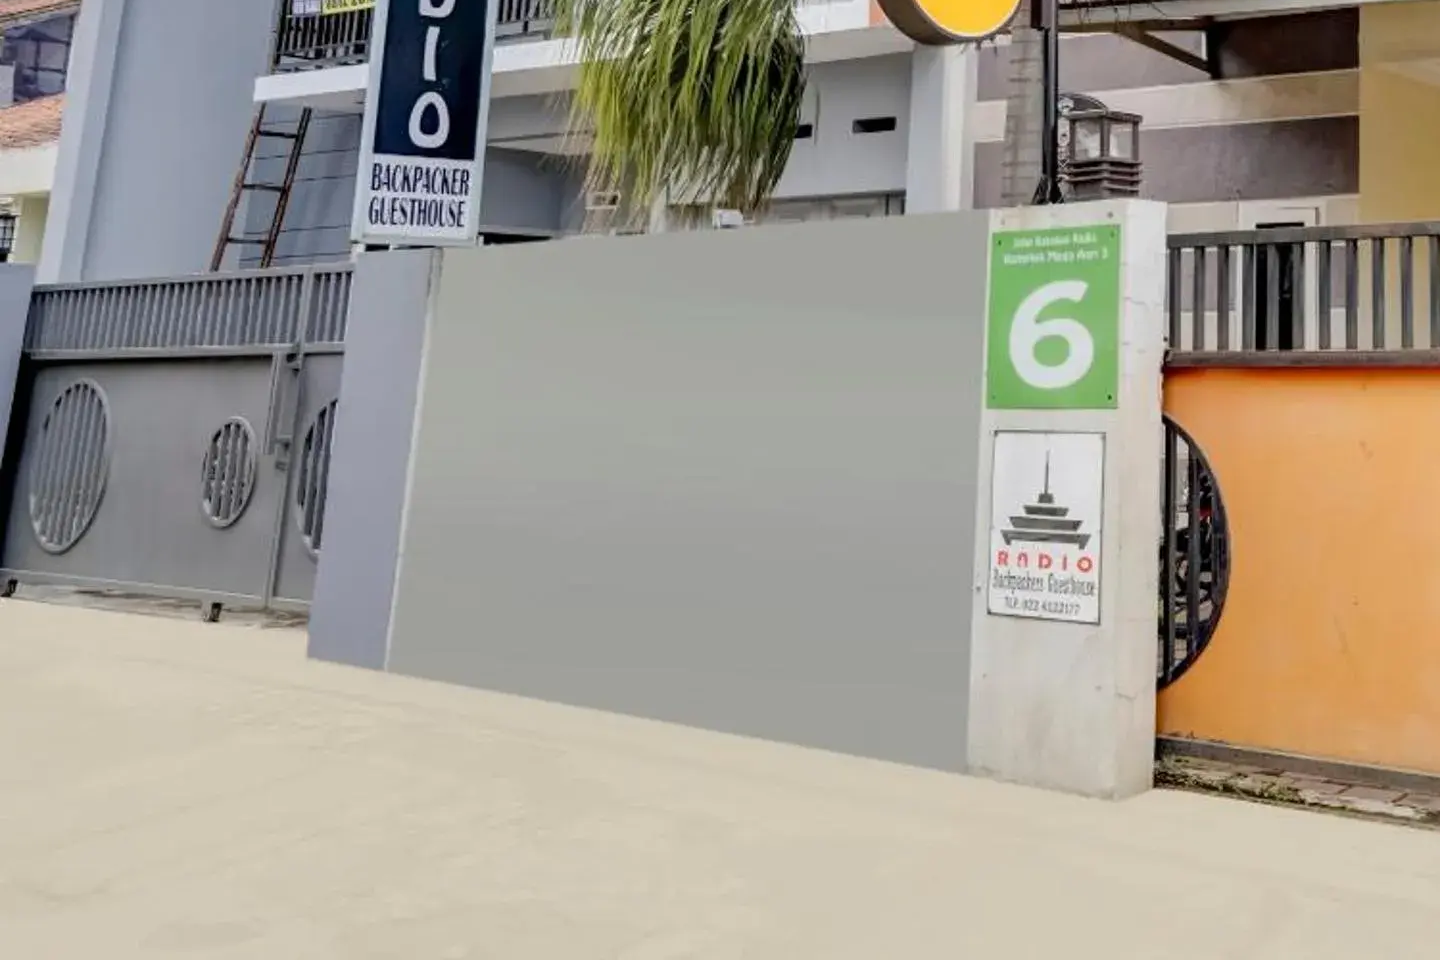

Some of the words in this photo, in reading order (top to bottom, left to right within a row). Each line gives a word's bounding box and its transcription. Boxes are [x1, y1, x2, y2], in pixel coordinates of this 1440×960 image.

[371, 162, 470, 196] BACKPACKER
[368, 195, 465, 228] GUESTHOUSE
[1008, 279, 1095, 389] 6
[997, 550, 1093, 573] RADIO
